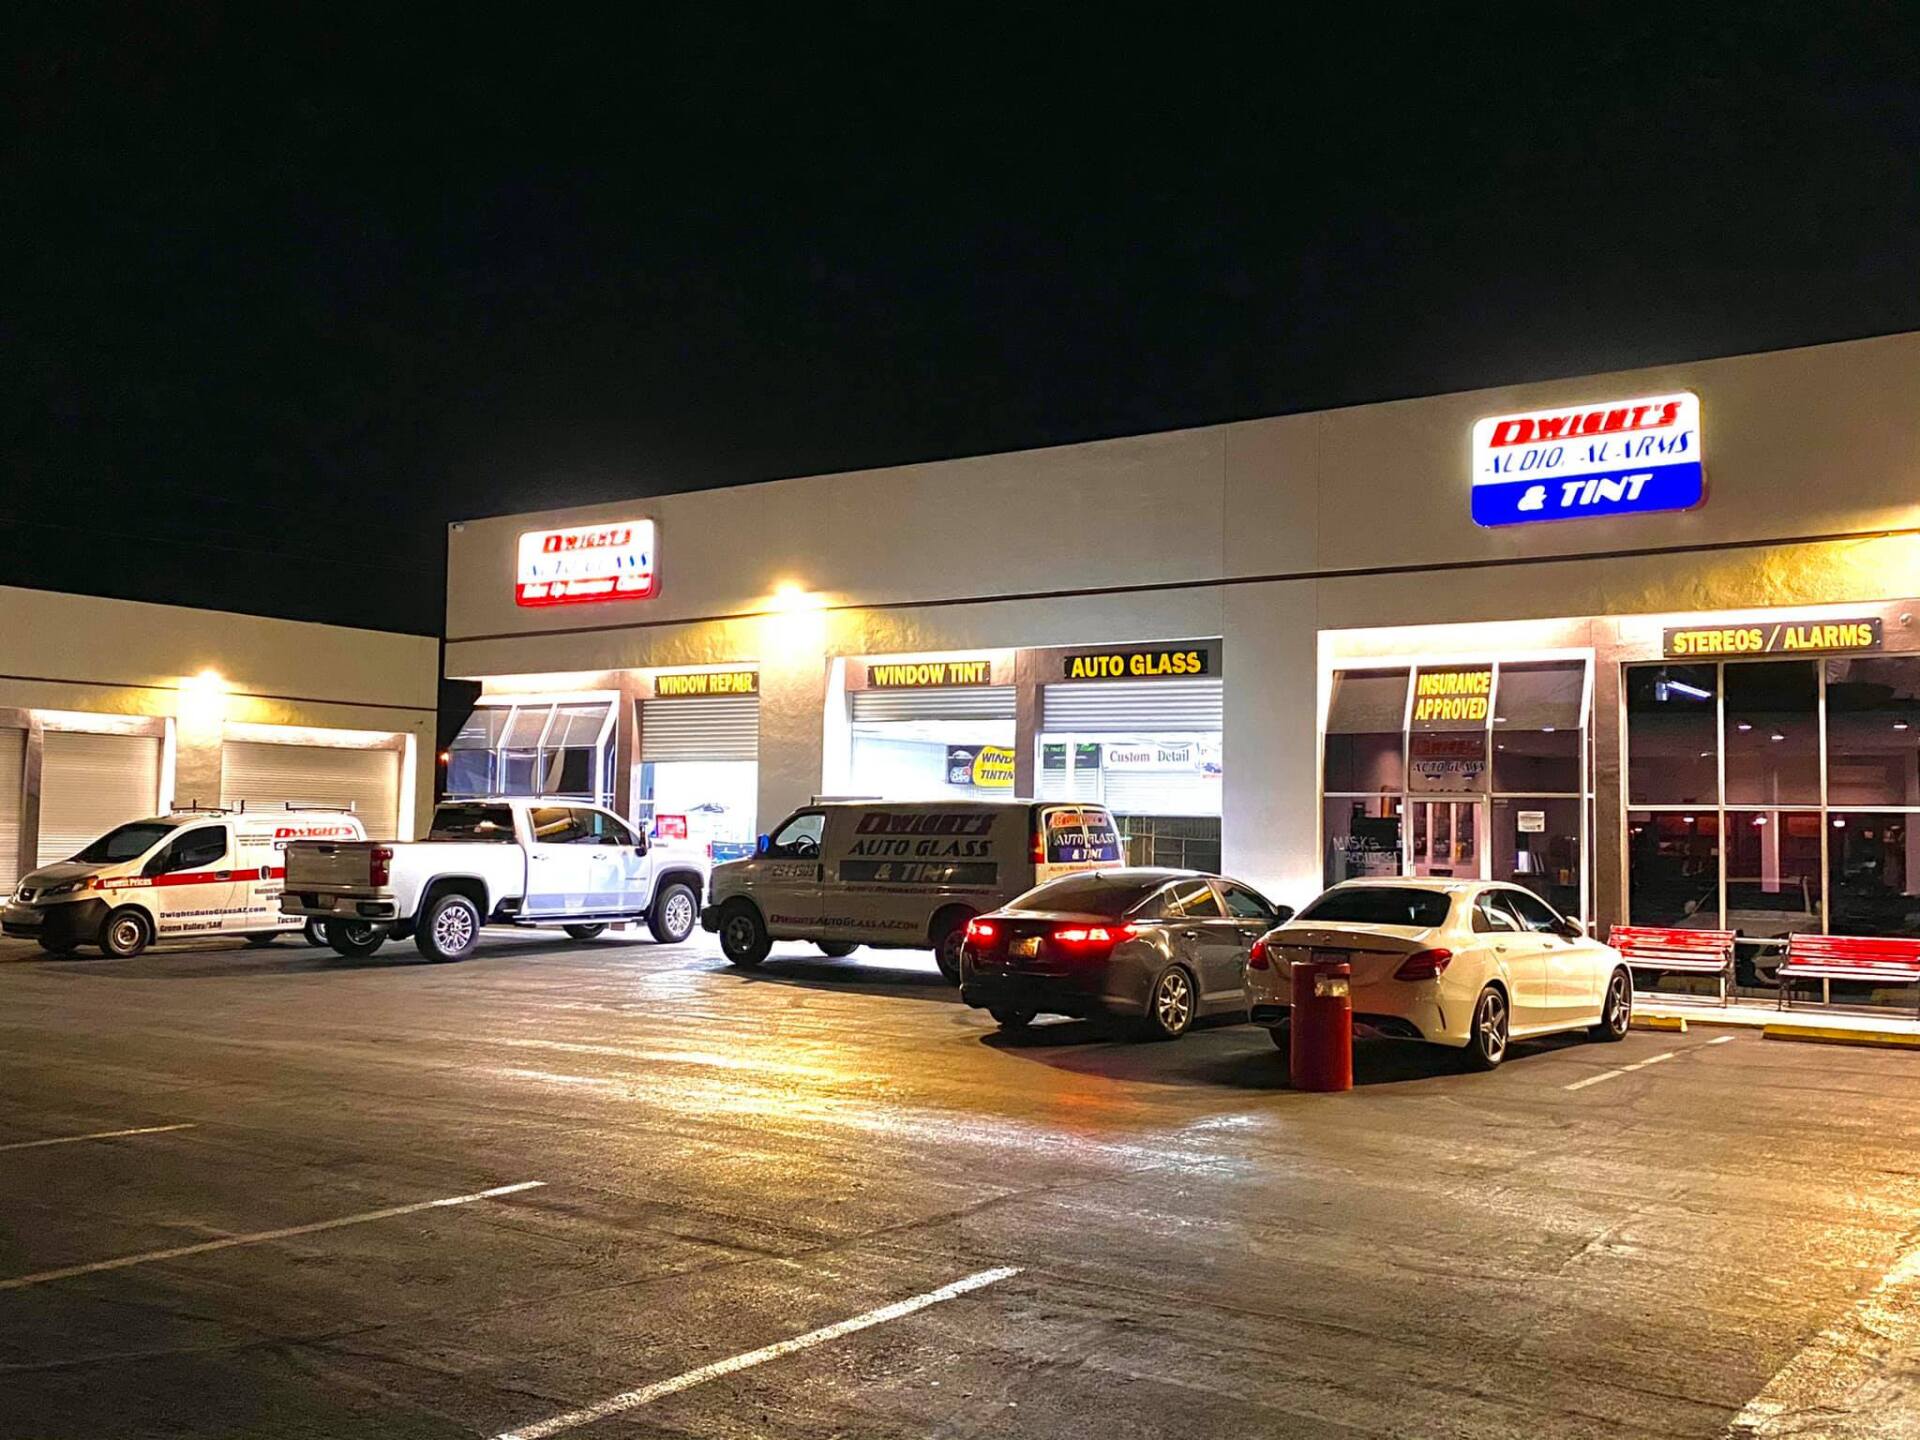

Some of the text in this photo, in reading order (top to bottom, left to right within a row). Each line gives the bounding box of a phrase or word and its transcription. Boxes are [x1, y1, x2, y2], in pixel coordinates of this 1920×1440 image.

[1489, 402, 1682, 448] DWIGHT'S
[1517, 474, 1653, 511] & TINT
[1673, 629, 1763, 654] STEREOS
[1783, 624, 1873, 648] ALARMS
[873, 661, 986, 685] WINDOW TINT
[1071, 652, 1201, 678] AUTO GLASS
[658, 672, 753, 694] WINDOW REPAIR
[1417, 672, 1491, 695] INSURANCE
[1415, 698, 1488, 720] APPROVED
[982, 752, 1013, 764] WIND
[1109, 749, 1190, 763] Custom Detail
[981, 769, 1014, 780] TINTIN
[855, 813, 998, 836] DWIGHT'S
[848, 840, 993, 857] AUTO GLASS
[1333, 836, 1381, 851] MASKS
[874, 863, 892, 880] &
